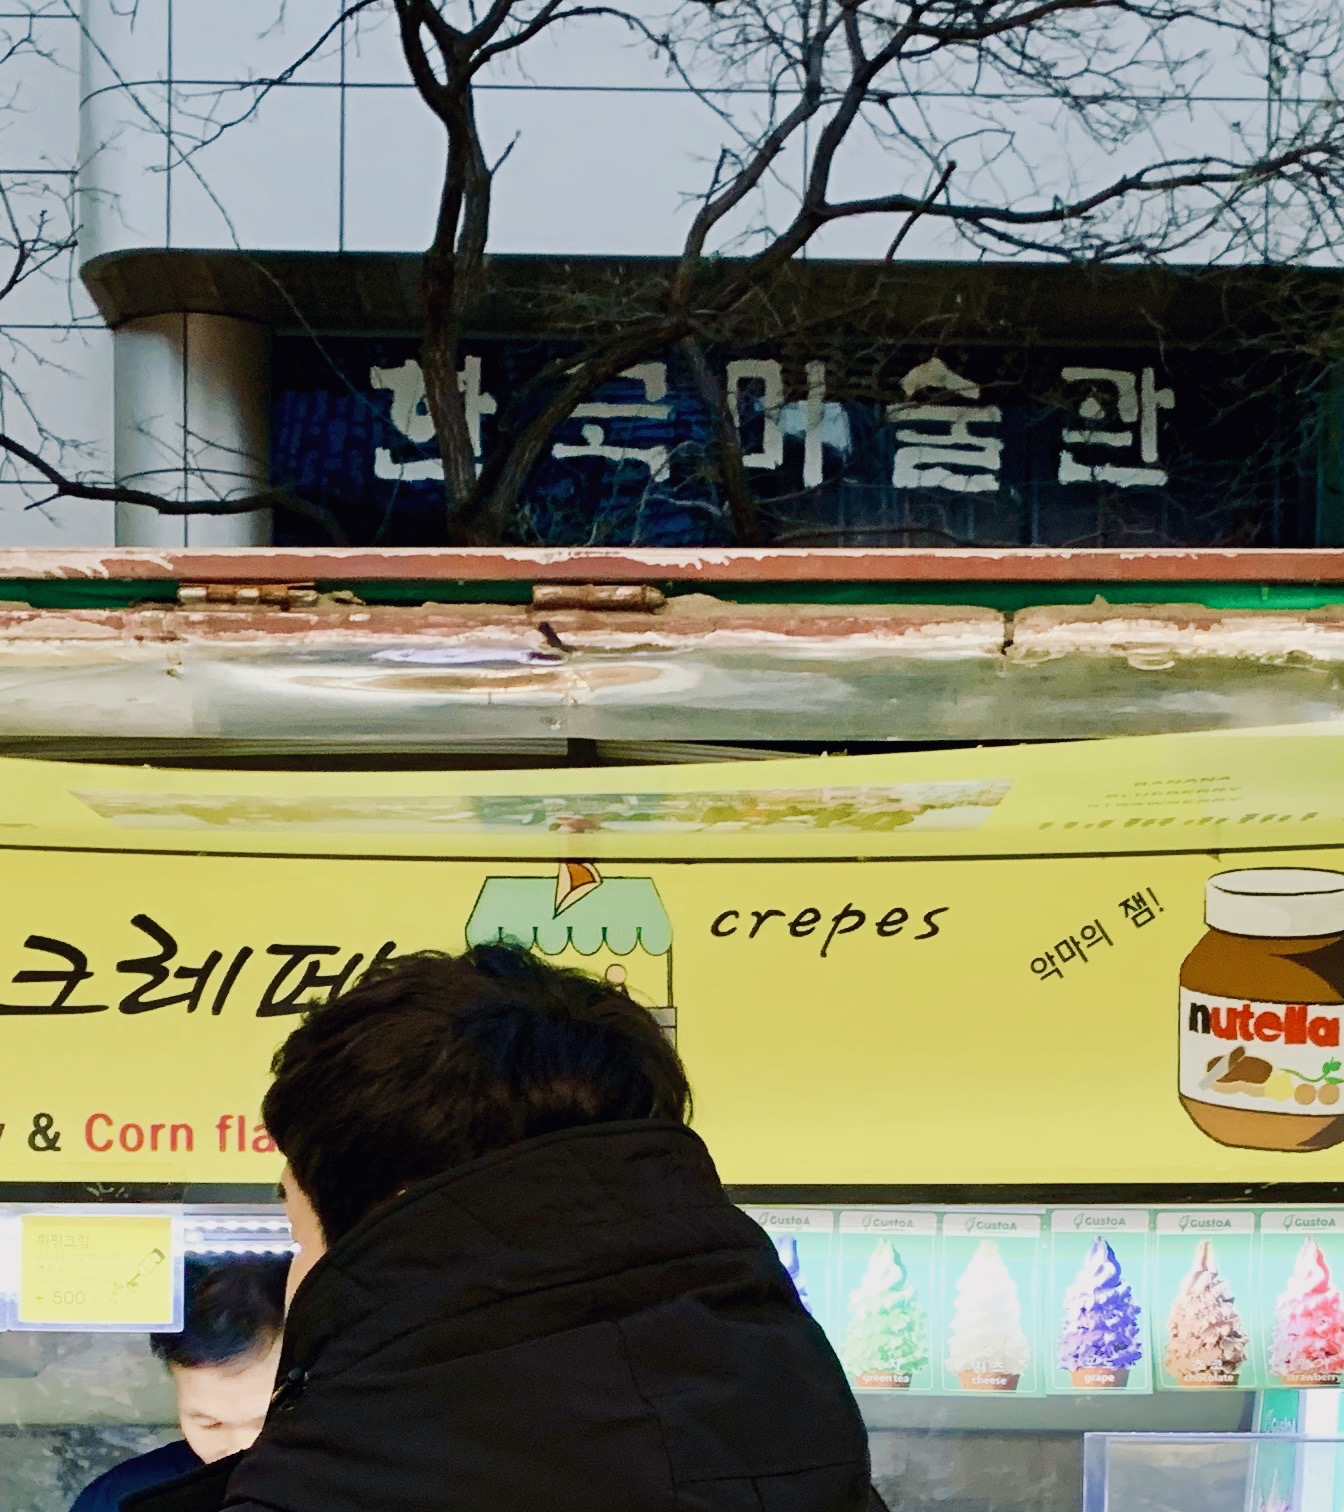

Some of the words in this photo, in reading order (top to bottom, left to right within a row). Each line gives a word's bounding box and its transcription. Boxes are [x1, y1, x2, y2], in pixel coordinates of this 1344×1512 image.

[710, 902, 950, 958] crepes
[1030, 919, 1114, 983] 악마의
[1117, 886, 1166, 932] 잼!
[1187, 999, 1341, 1048] nutella
[27, 1110, 63, 1153] &
[83, 1111, 194, 1153] Corn
[52, 1290, 86, 1305] 500
[862, 1375, 892, 1383] green
[894, 1374, 910, 1383] tea
[971, 1374, 1007, 1386] cheese
[1084, 1374, 1116, 1384] grape
[1183, 1373, 1235, 1383] chocolate
